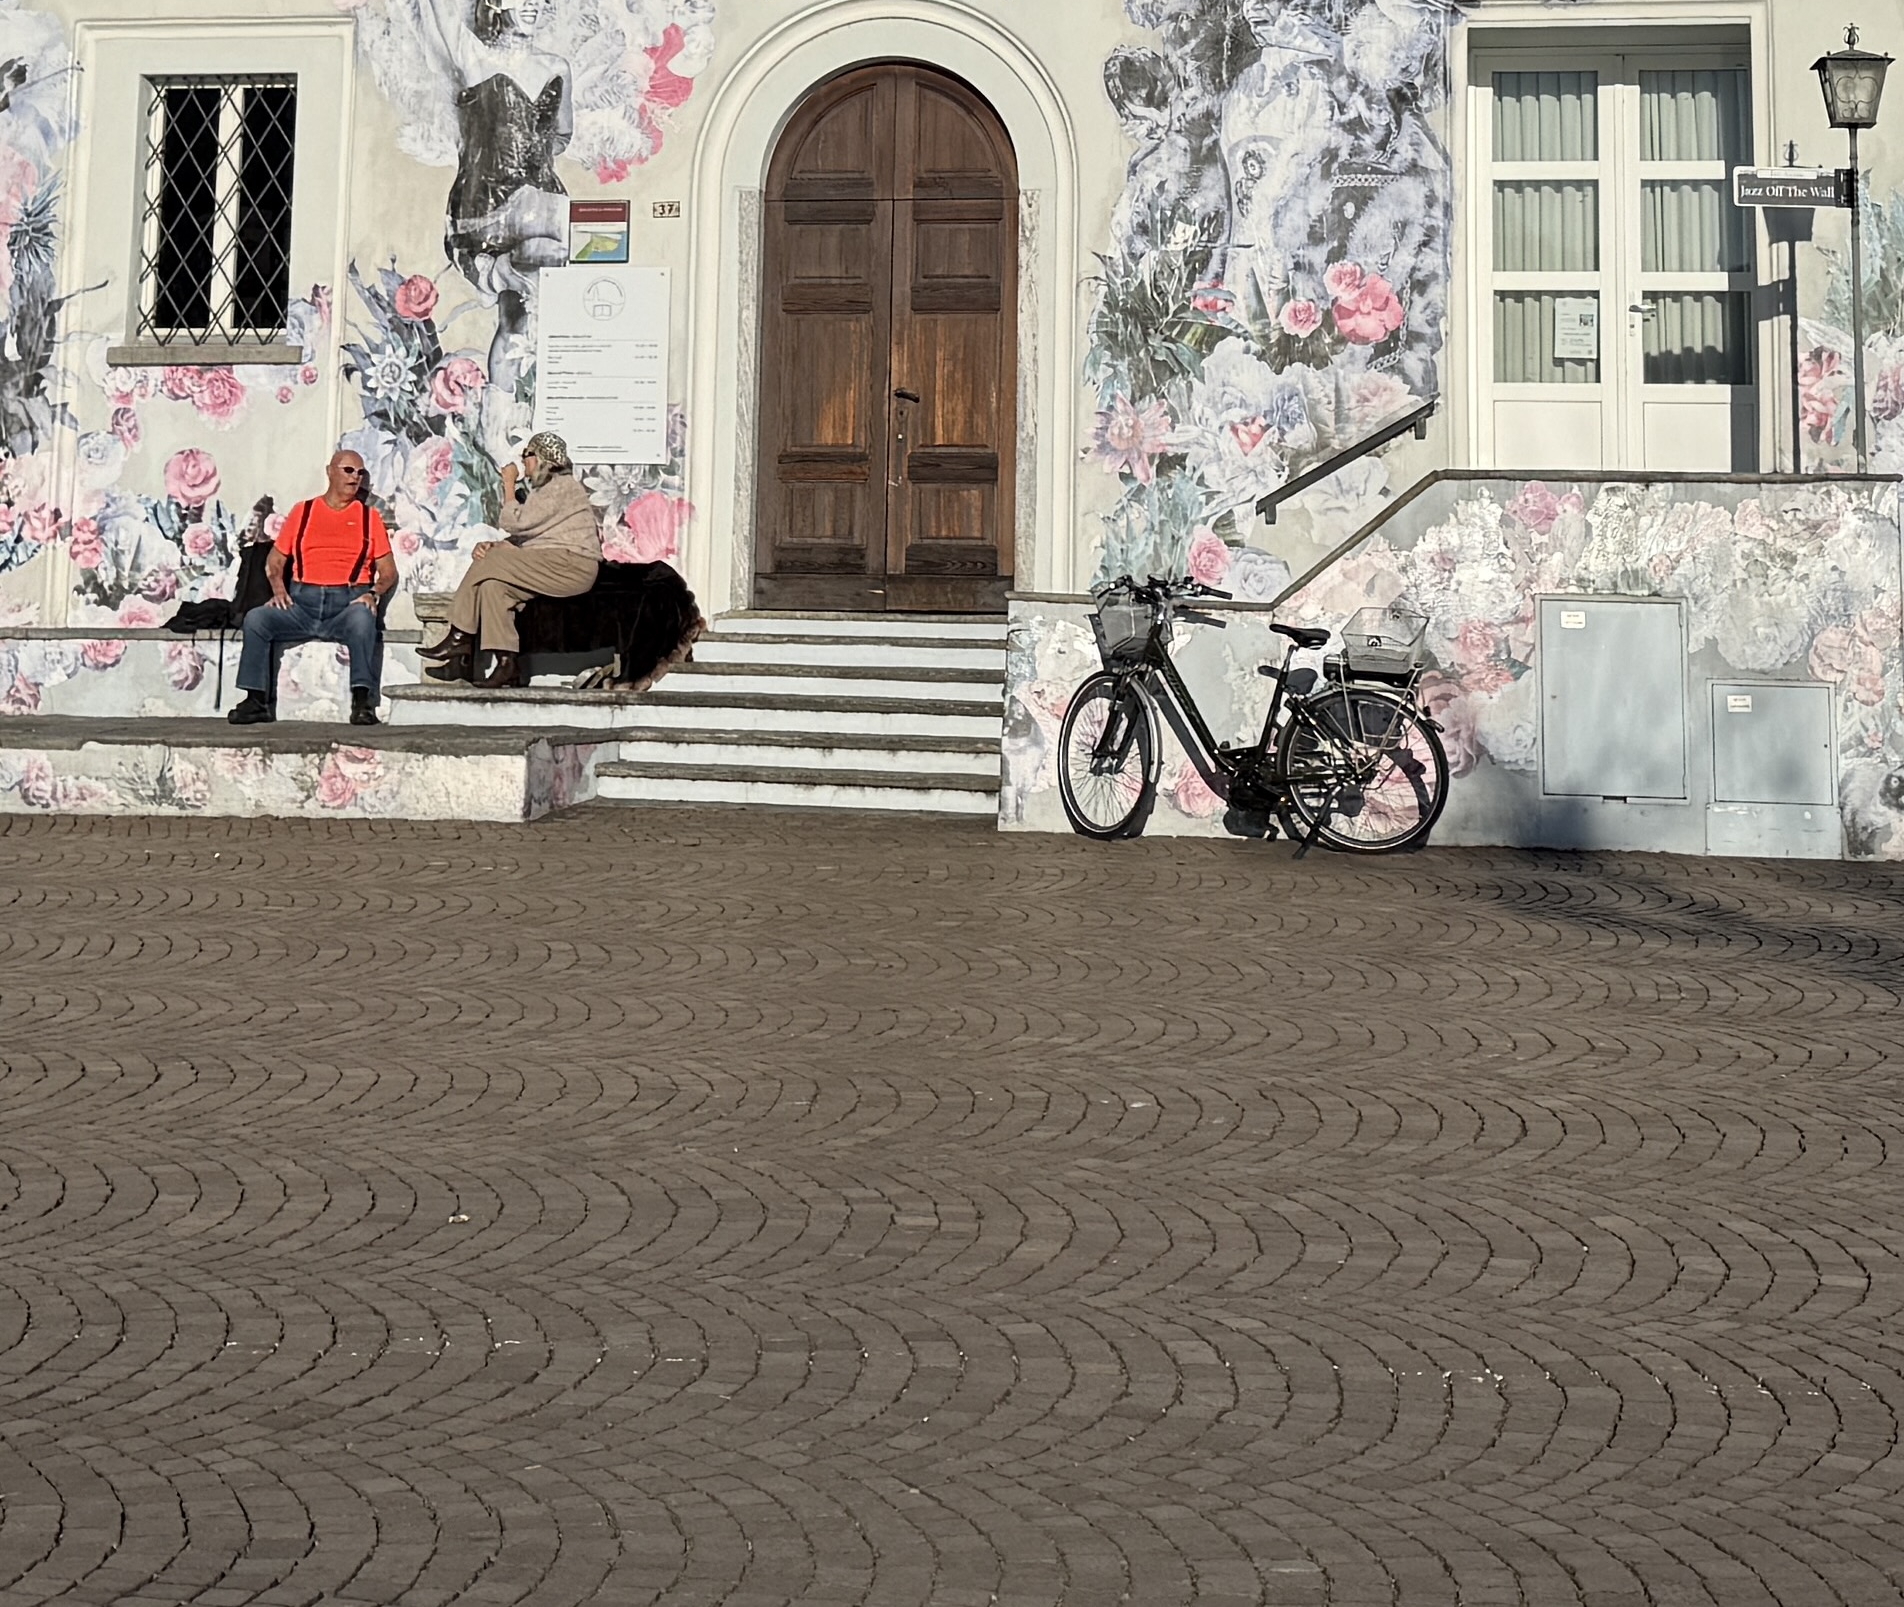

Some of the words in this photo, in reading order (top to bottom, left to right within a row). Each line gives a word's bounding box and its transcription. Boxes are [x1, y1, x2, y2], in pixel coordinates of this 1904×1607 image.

[1740, 184, 1763, 198] Jazz
[1765, 185, 1784, 198] Off
[1785, 186, 1808, 198] The
[1810, 186, 1835, 199] Wall
[658, 204, 675, 216] 37
